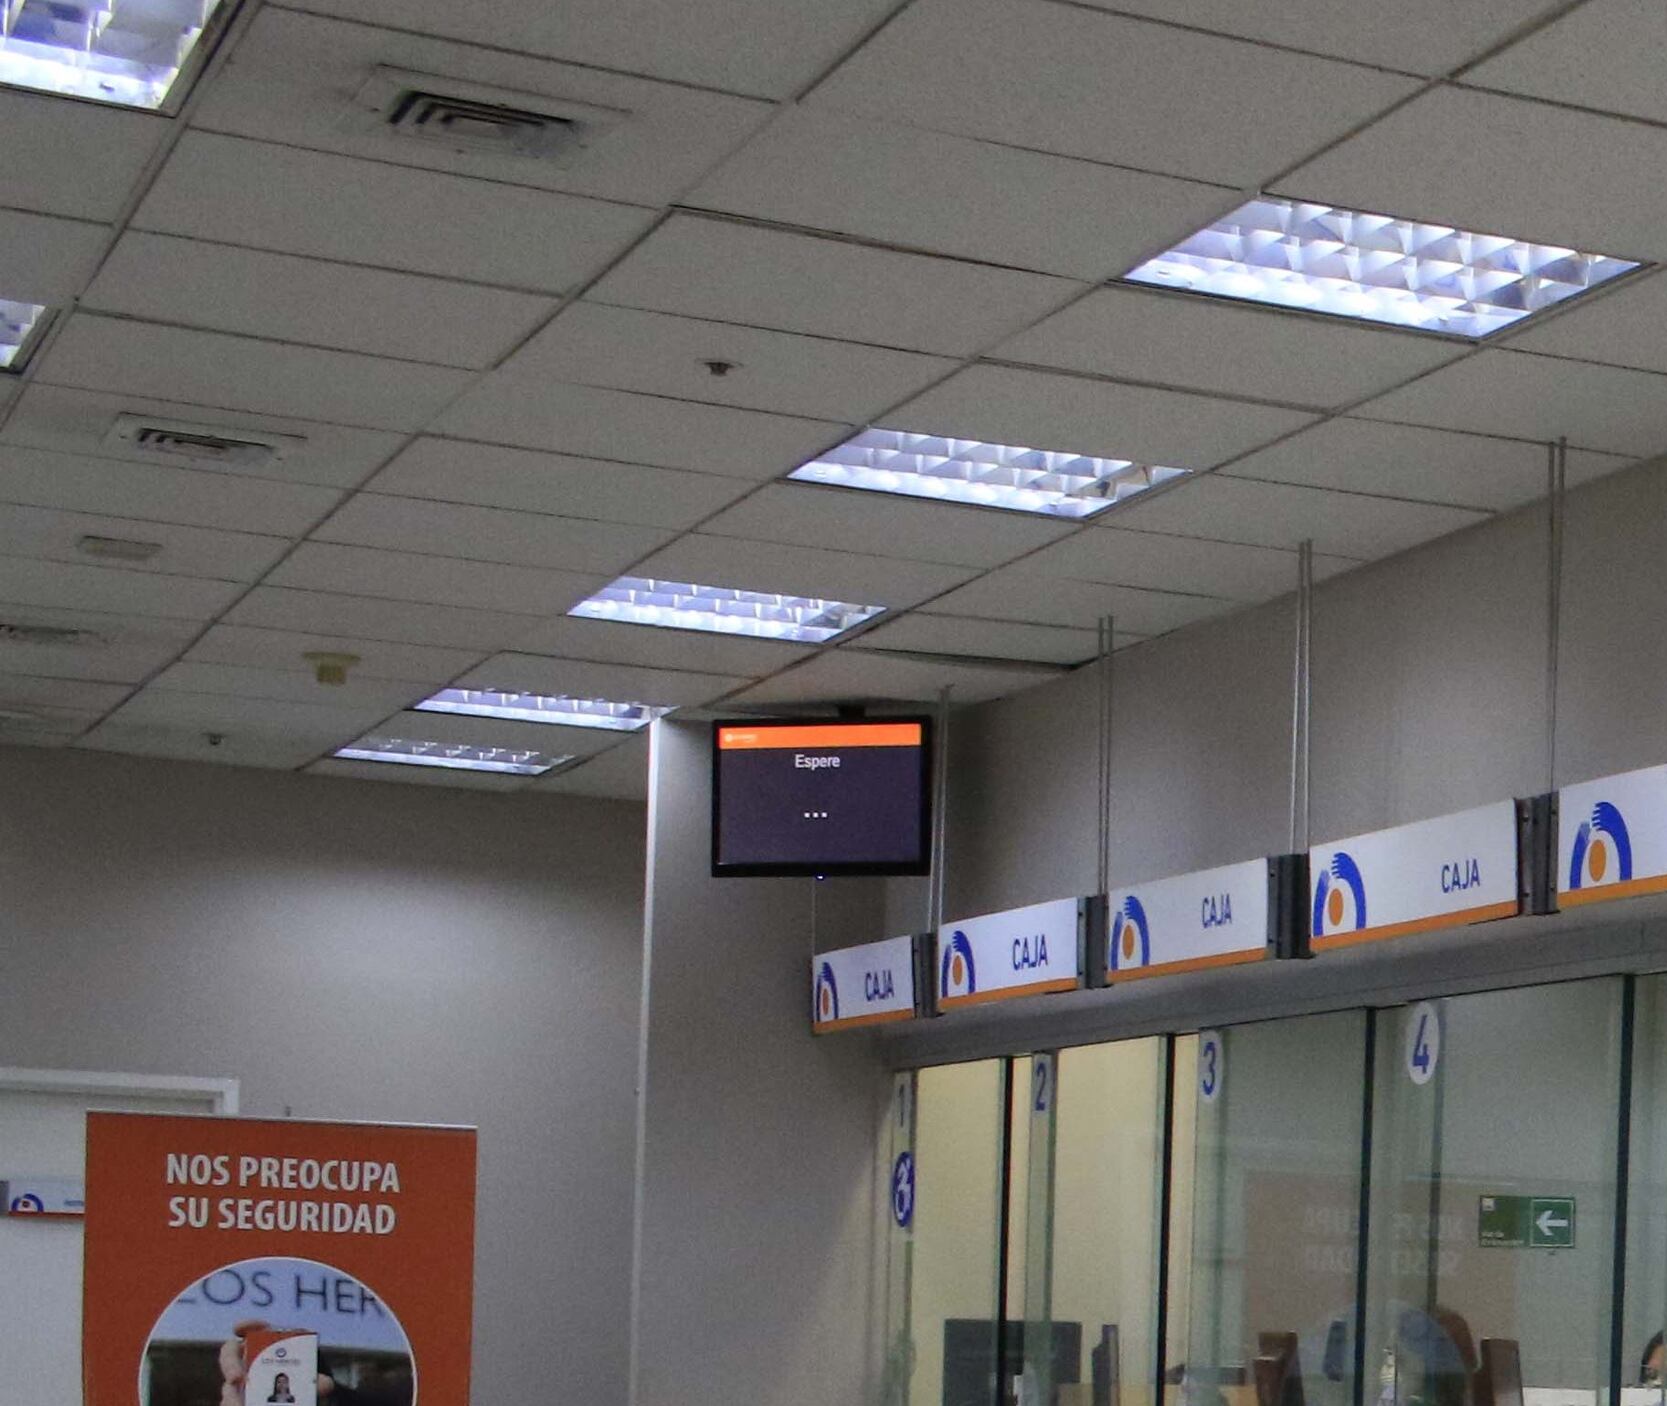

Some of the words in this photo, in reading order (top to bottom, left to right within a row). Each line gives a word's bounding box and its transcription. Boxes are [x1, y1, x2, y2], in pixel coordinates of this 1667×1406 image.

[794, 754, 841, 770] Espere
[1441, 859, 1481, 893] CAJA
[1202, 893, 1232, 929] CAJA
[1013, 934, 1048, 971] CAJA
[865, 969, 894, 1002] CAJA
[1413, 1014, 1430, 1075] 4
[1035, 1062, 1047, 1112] 2
[1202, 1042, 1217, 1096] 3
[167, 1153, 230, 1186] NOS
[239, 1156, 400, 1193] PREOCUPA
[168, 1197, 209, 1228] SU
[218, 1199, 397, 1235] SEGURIDAD
